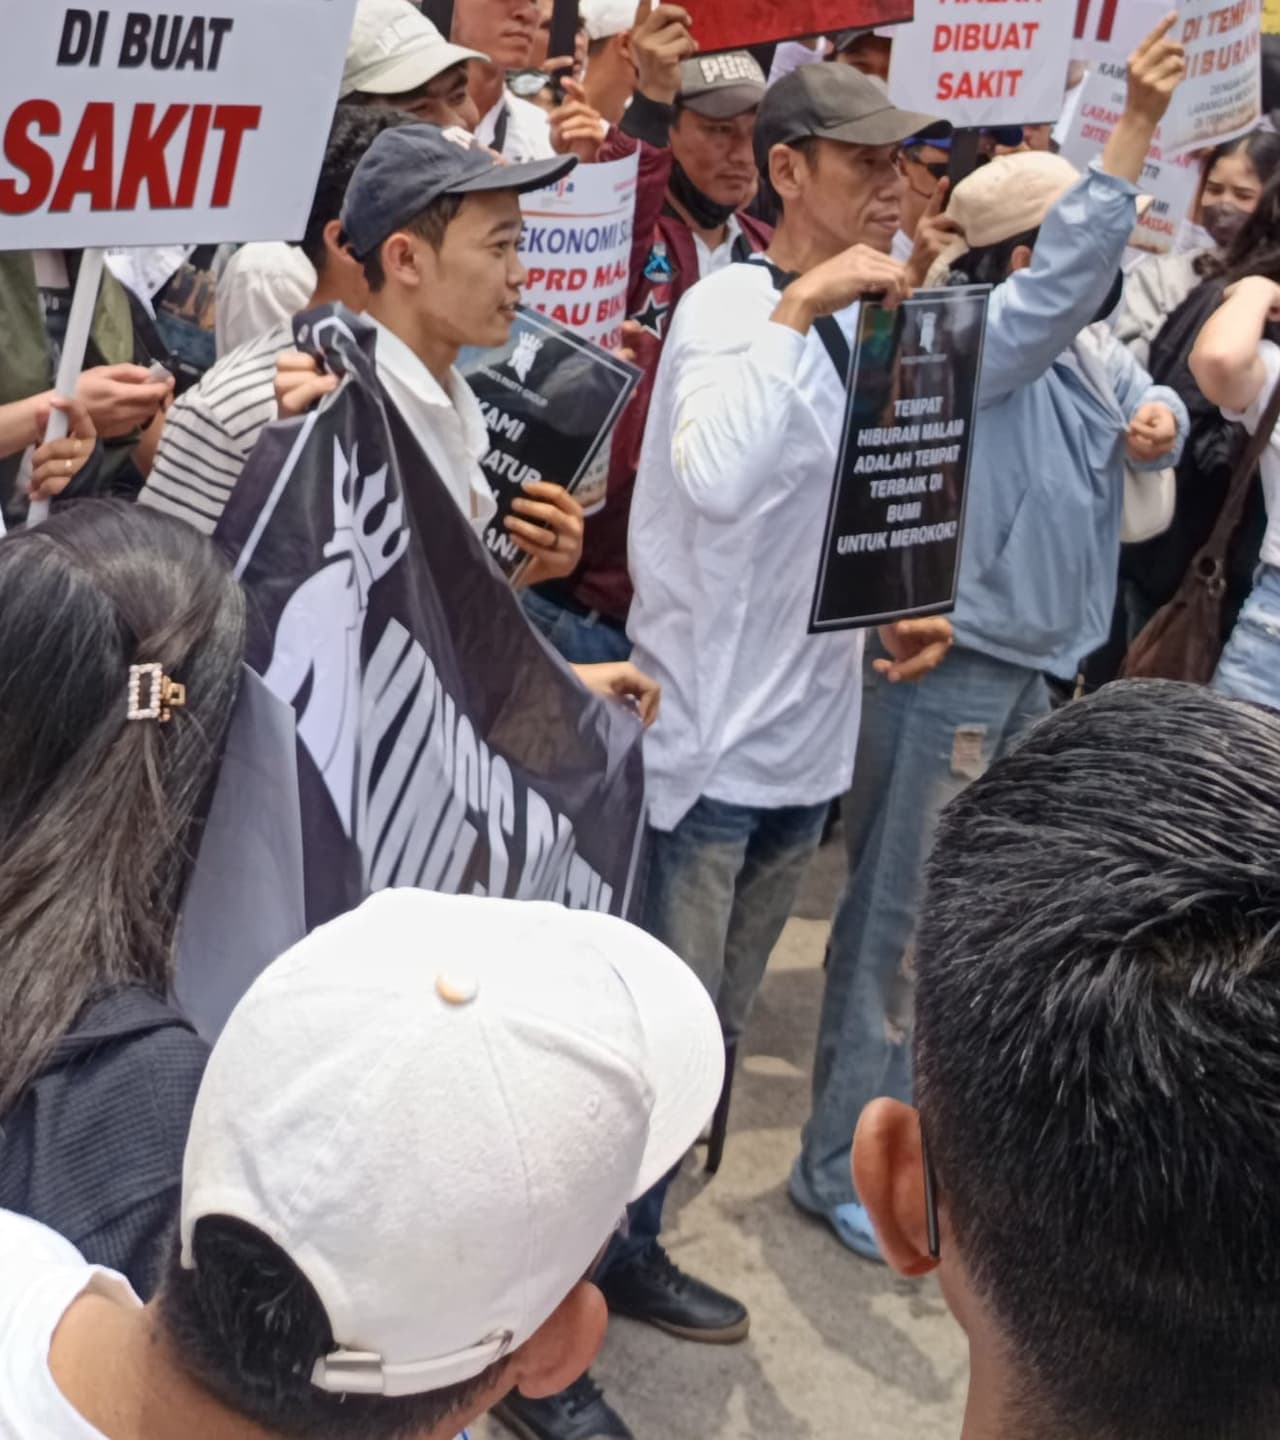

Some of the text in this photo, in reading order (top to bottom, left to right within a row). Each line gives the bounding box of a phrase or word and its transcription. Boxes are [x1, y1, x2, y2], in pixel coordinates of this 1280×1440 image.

[56, 9, 233, 71] DI BUAT
[933, 23, 1039, 52] DIBUAT
[936, 70, 1023, 100] SAKIT
[524, 267, 587, 291] PRD
[894, 396, 943, 417] TEMPAT
[857, 419, 964, 446] HIBURAN MALAM
[853, 445, 960, 474] ADALAH TEMPAT
[870, 476, 927, 499] TERBAIK
[886, 502, 921, 524] BUMI
[837, 530, 886, 554] UNTUK
